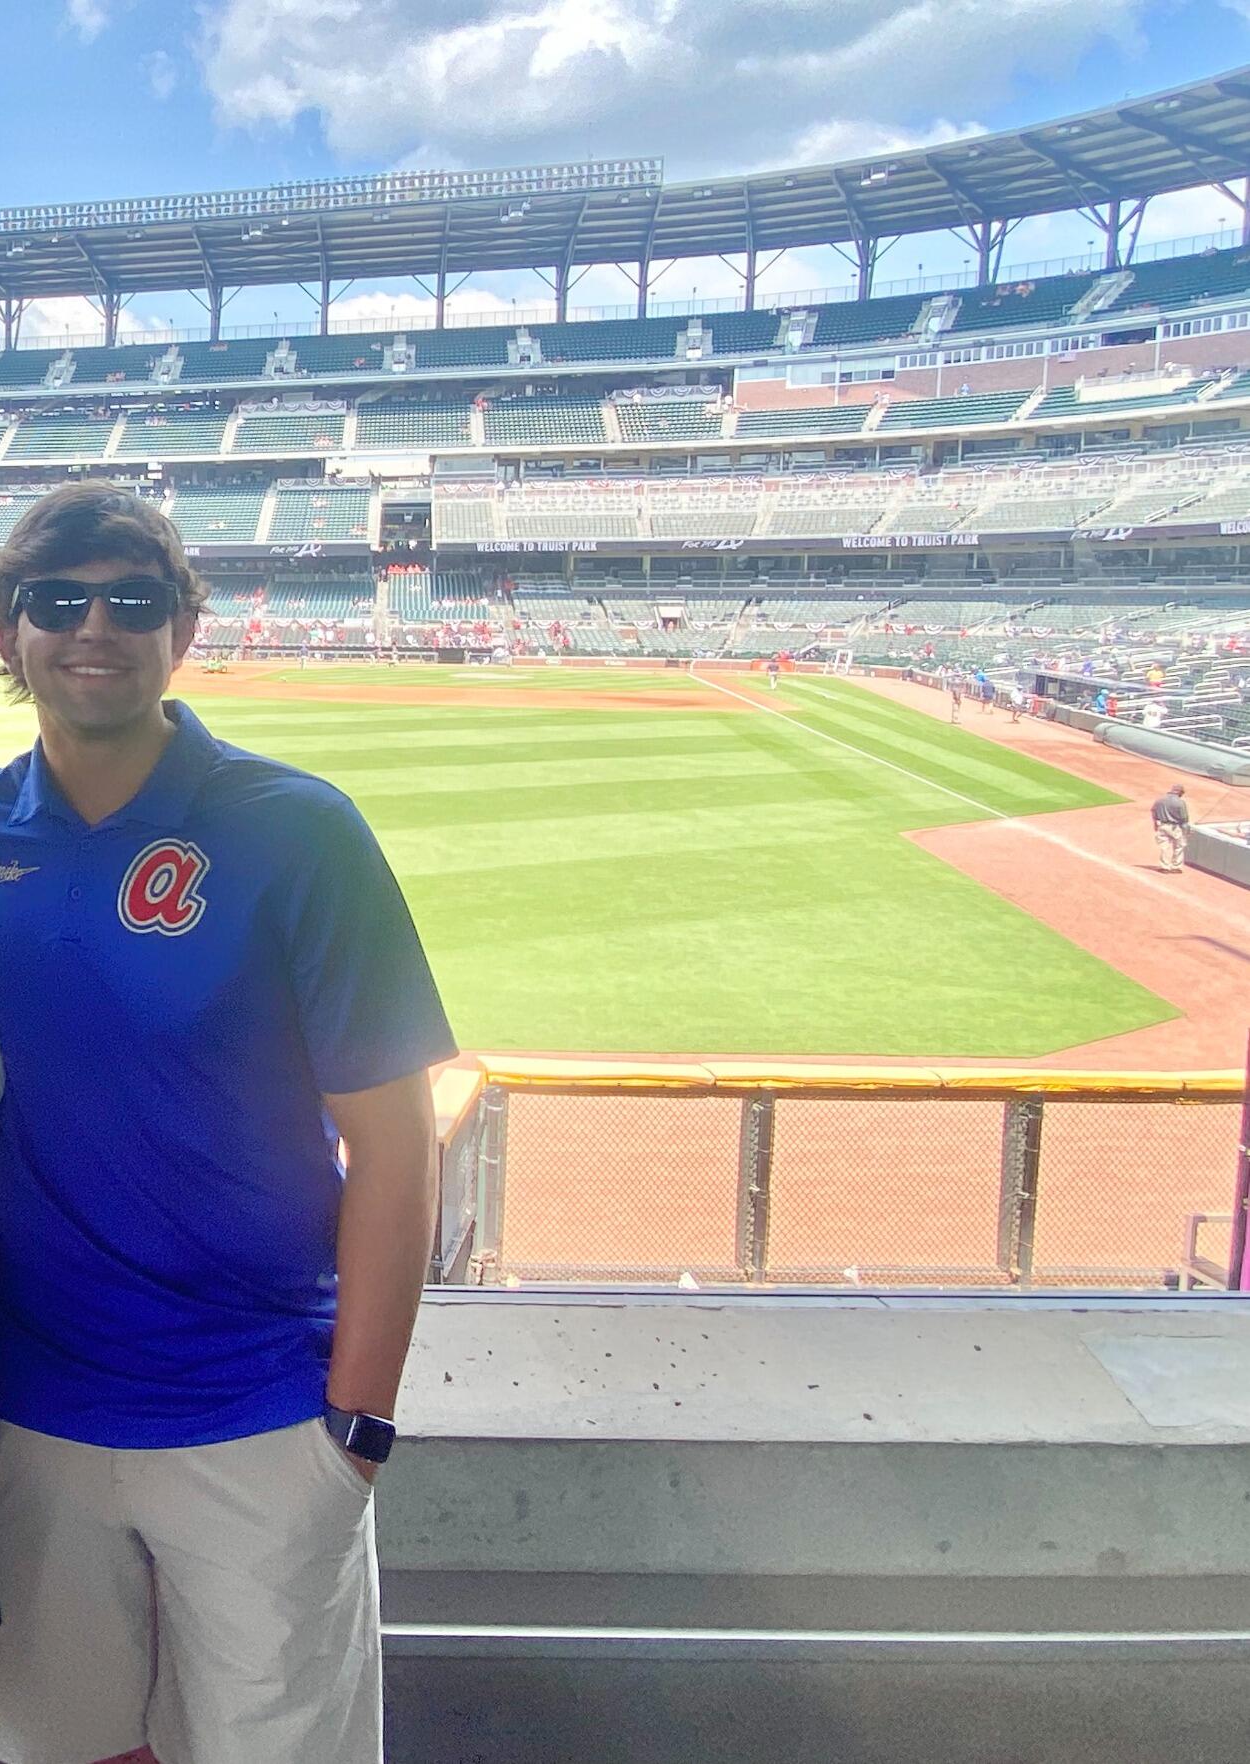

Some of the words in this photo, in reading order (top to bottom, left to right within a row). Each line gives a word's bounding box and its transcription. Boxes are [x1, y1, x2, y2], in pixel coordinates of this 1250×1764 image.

[477, 542, 519, 552] WELCOME
[522, 542, 534, 552] TO
[537, 541, 569, 551] TRUIST
[572, 541, 597, 551] PARK
[842, 537, 892, 548] WELCOME
[895, 536, 908, 546] TO
[911, 535, 948, 546] TRUIST
[951, 534, 979, 545] PARK
